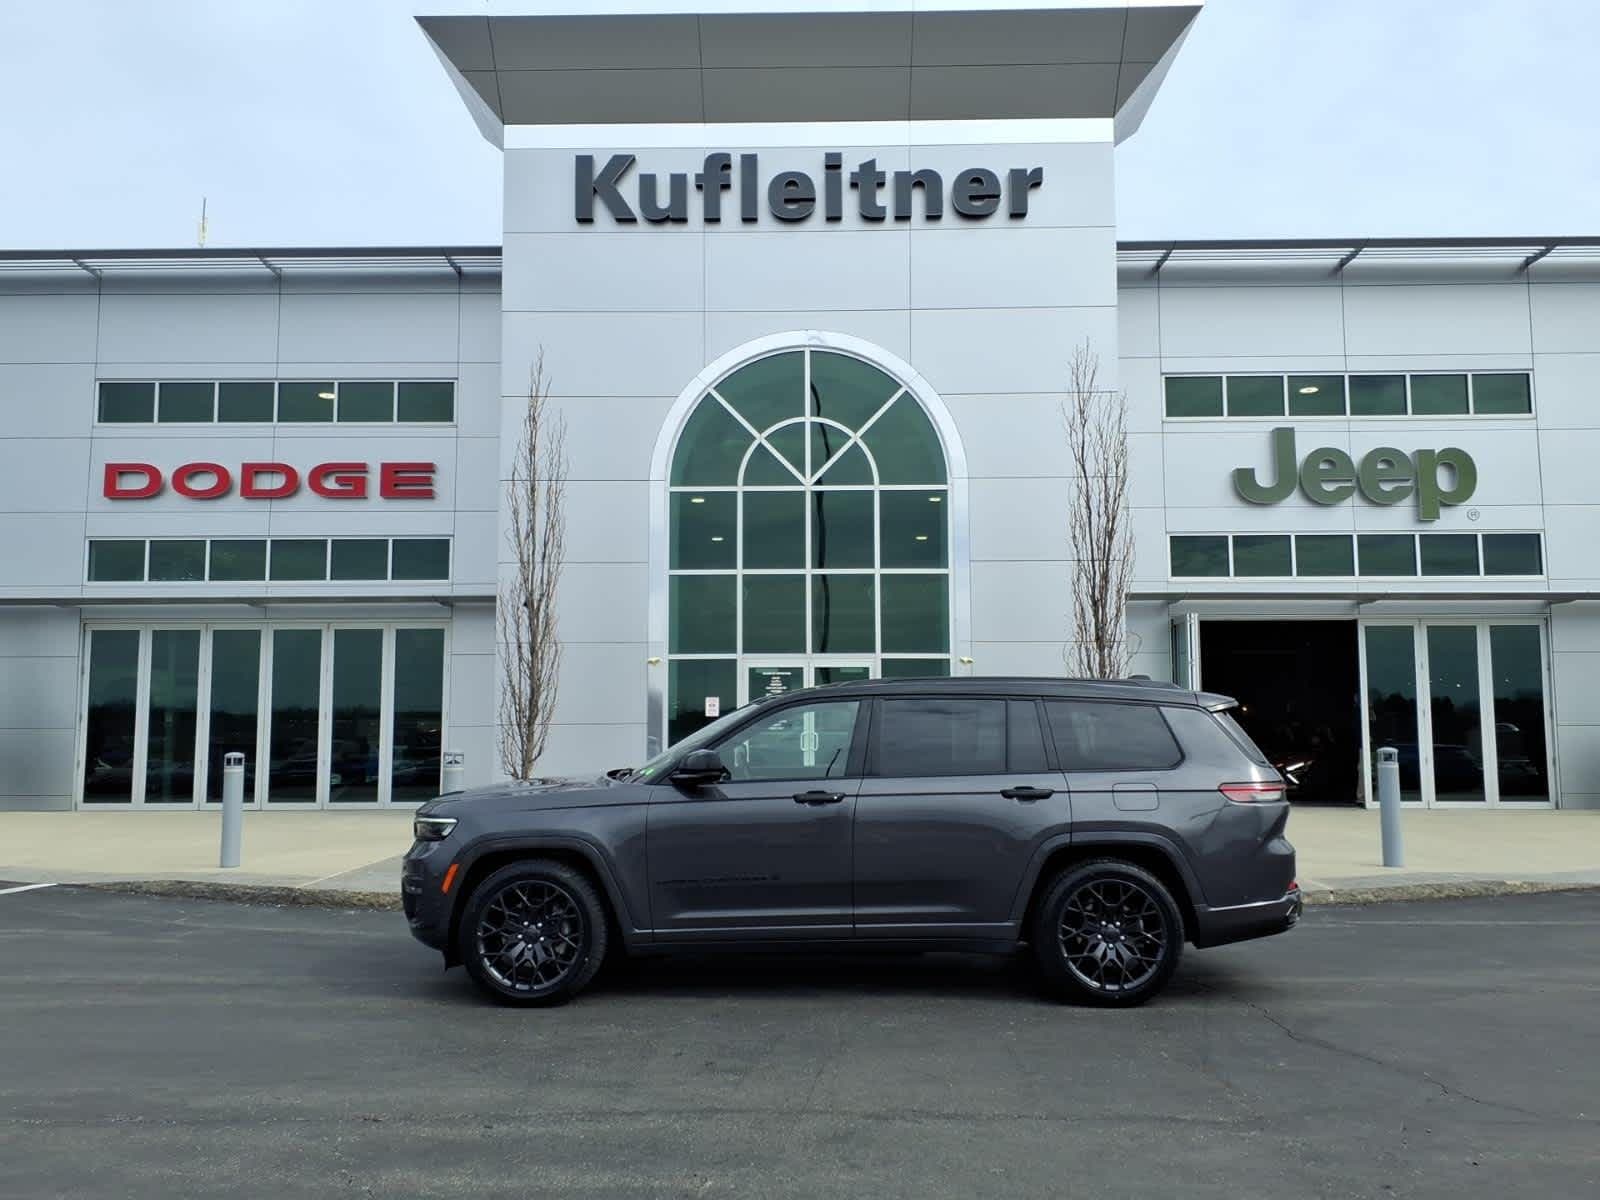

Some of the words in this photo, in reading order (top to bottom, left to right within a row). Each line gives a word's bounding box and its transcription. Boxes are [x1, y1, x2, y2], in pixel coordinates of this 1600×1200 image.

[575, 152, 1043, 223] Kufleitner
[104, 463, 436, 499] DODGE
[1234, 427, 1477, 521] Jeep
